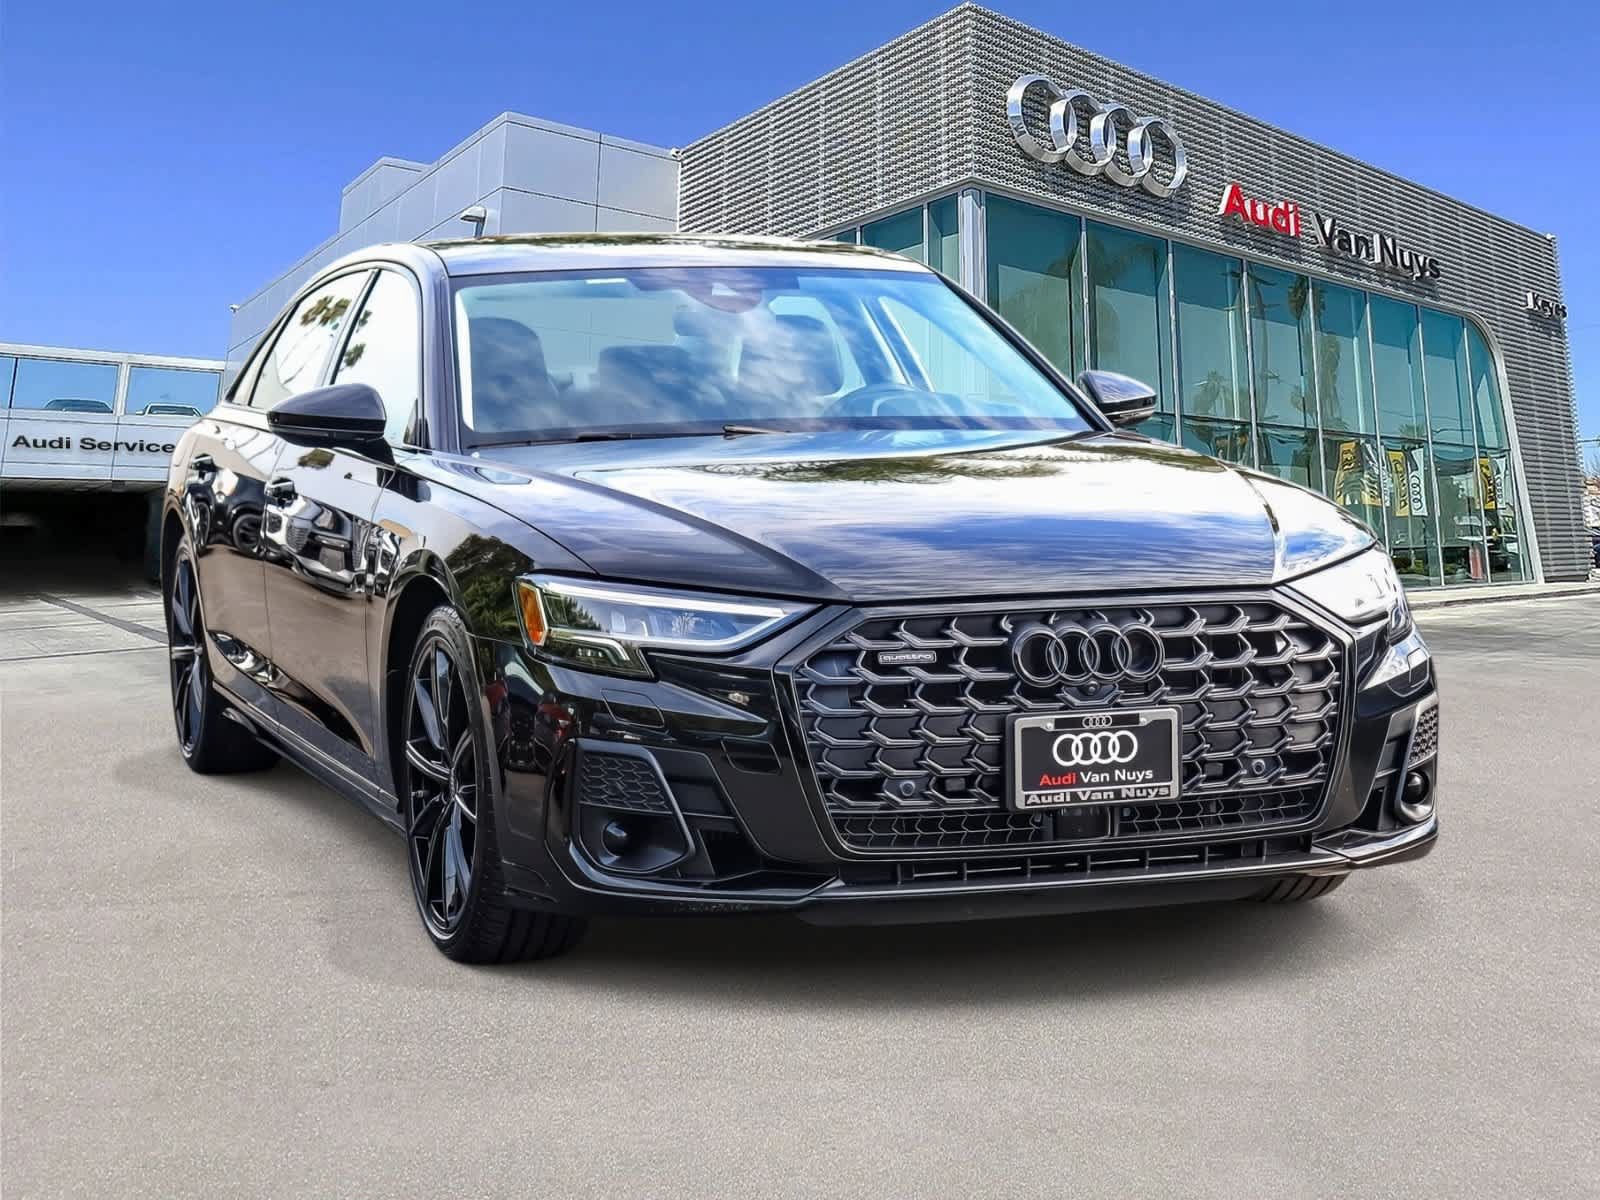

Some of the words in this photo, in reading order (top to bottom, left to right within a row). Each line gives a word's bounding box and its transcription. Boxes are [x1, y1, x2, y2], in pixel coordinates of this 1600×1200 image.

[1219, 182, 1302, 237] Audi
[1312, 212, 1371, 259] Van
[1371, 233, 1441, 281] Nuys
[12, 434, 71, 450] Audi
[79, 437, 175, 454] Service
[1040, 773, 1076, 786] Audi
[1080, 771, 1110, 784] Van
[1114, 769, 1153, 783] Nuys
[1026, 792, 1071, 805] Audi
[1077, 790, 1114, 801] Van
[1121, 786, 1170, 799] Nuys
